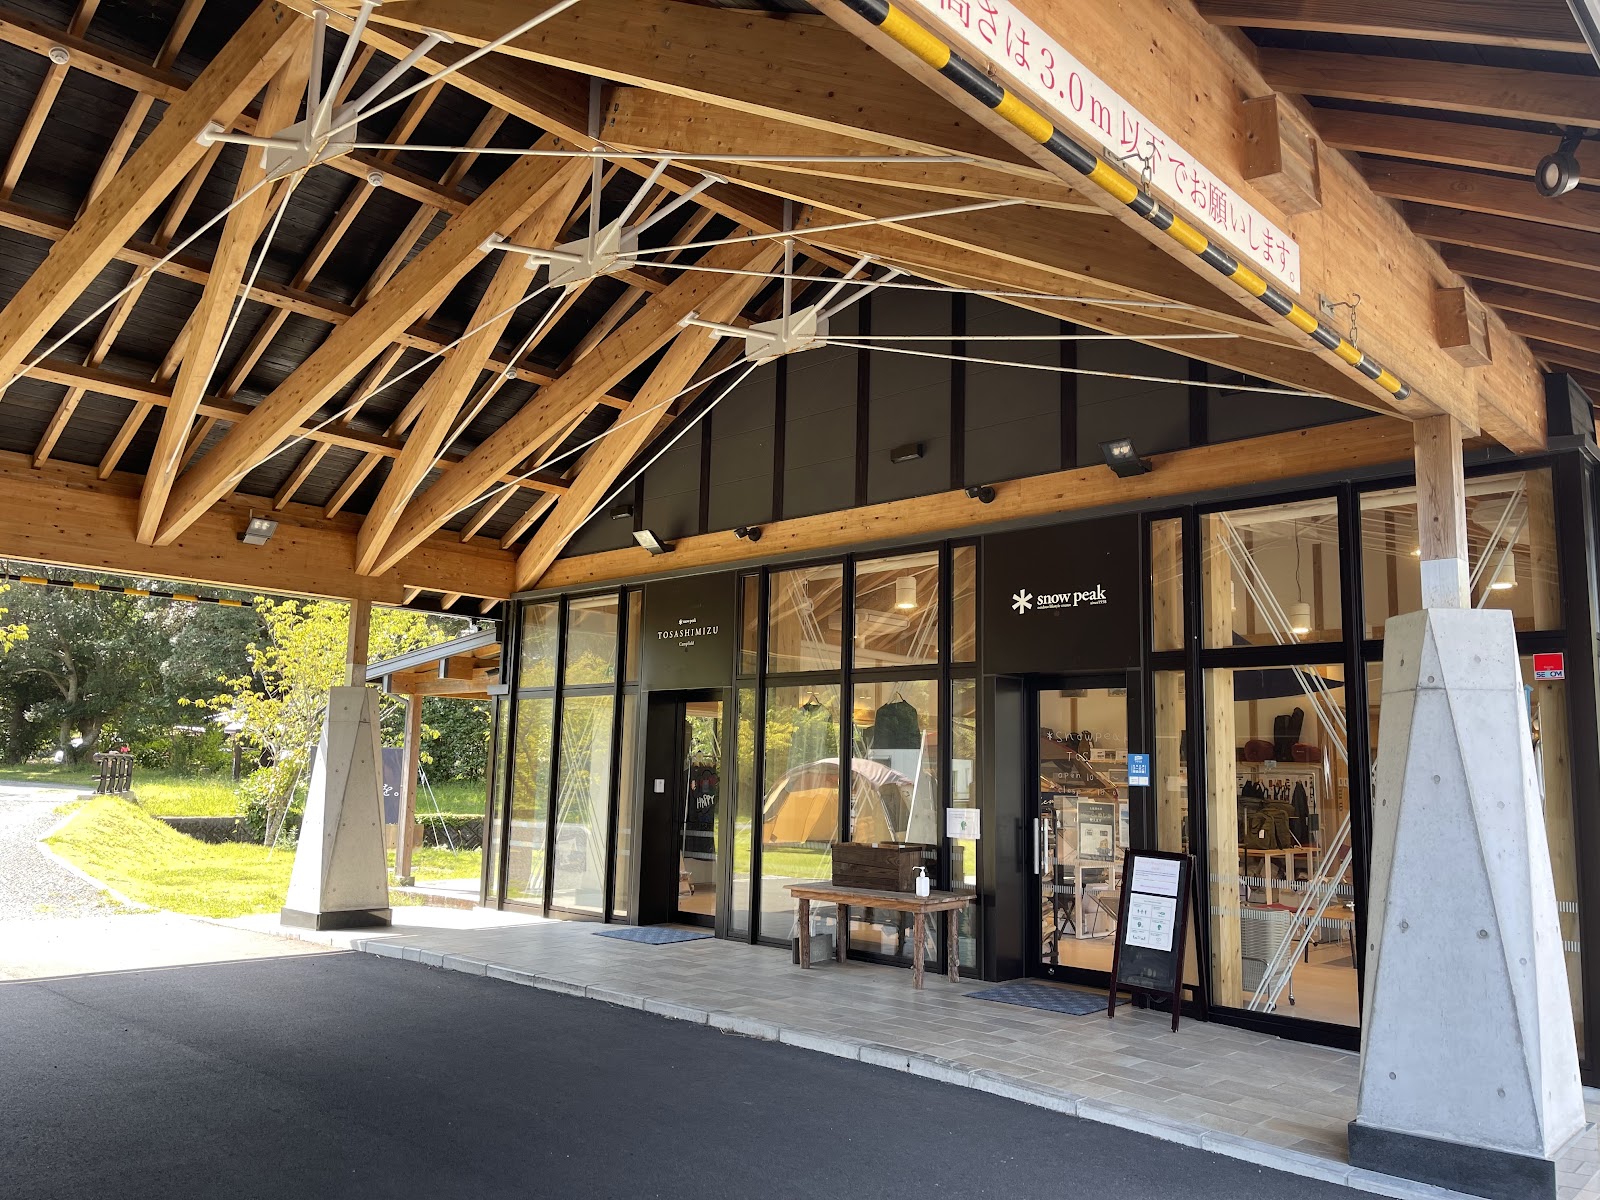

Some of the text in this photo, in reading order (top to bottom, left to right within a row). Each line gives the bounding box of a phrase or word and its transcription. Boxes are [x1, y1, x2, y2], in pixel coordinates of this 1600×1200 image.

[1037, 584, 1107, 607] snow peak
[657, 626, 719, 640] TOSASHIMIZU
